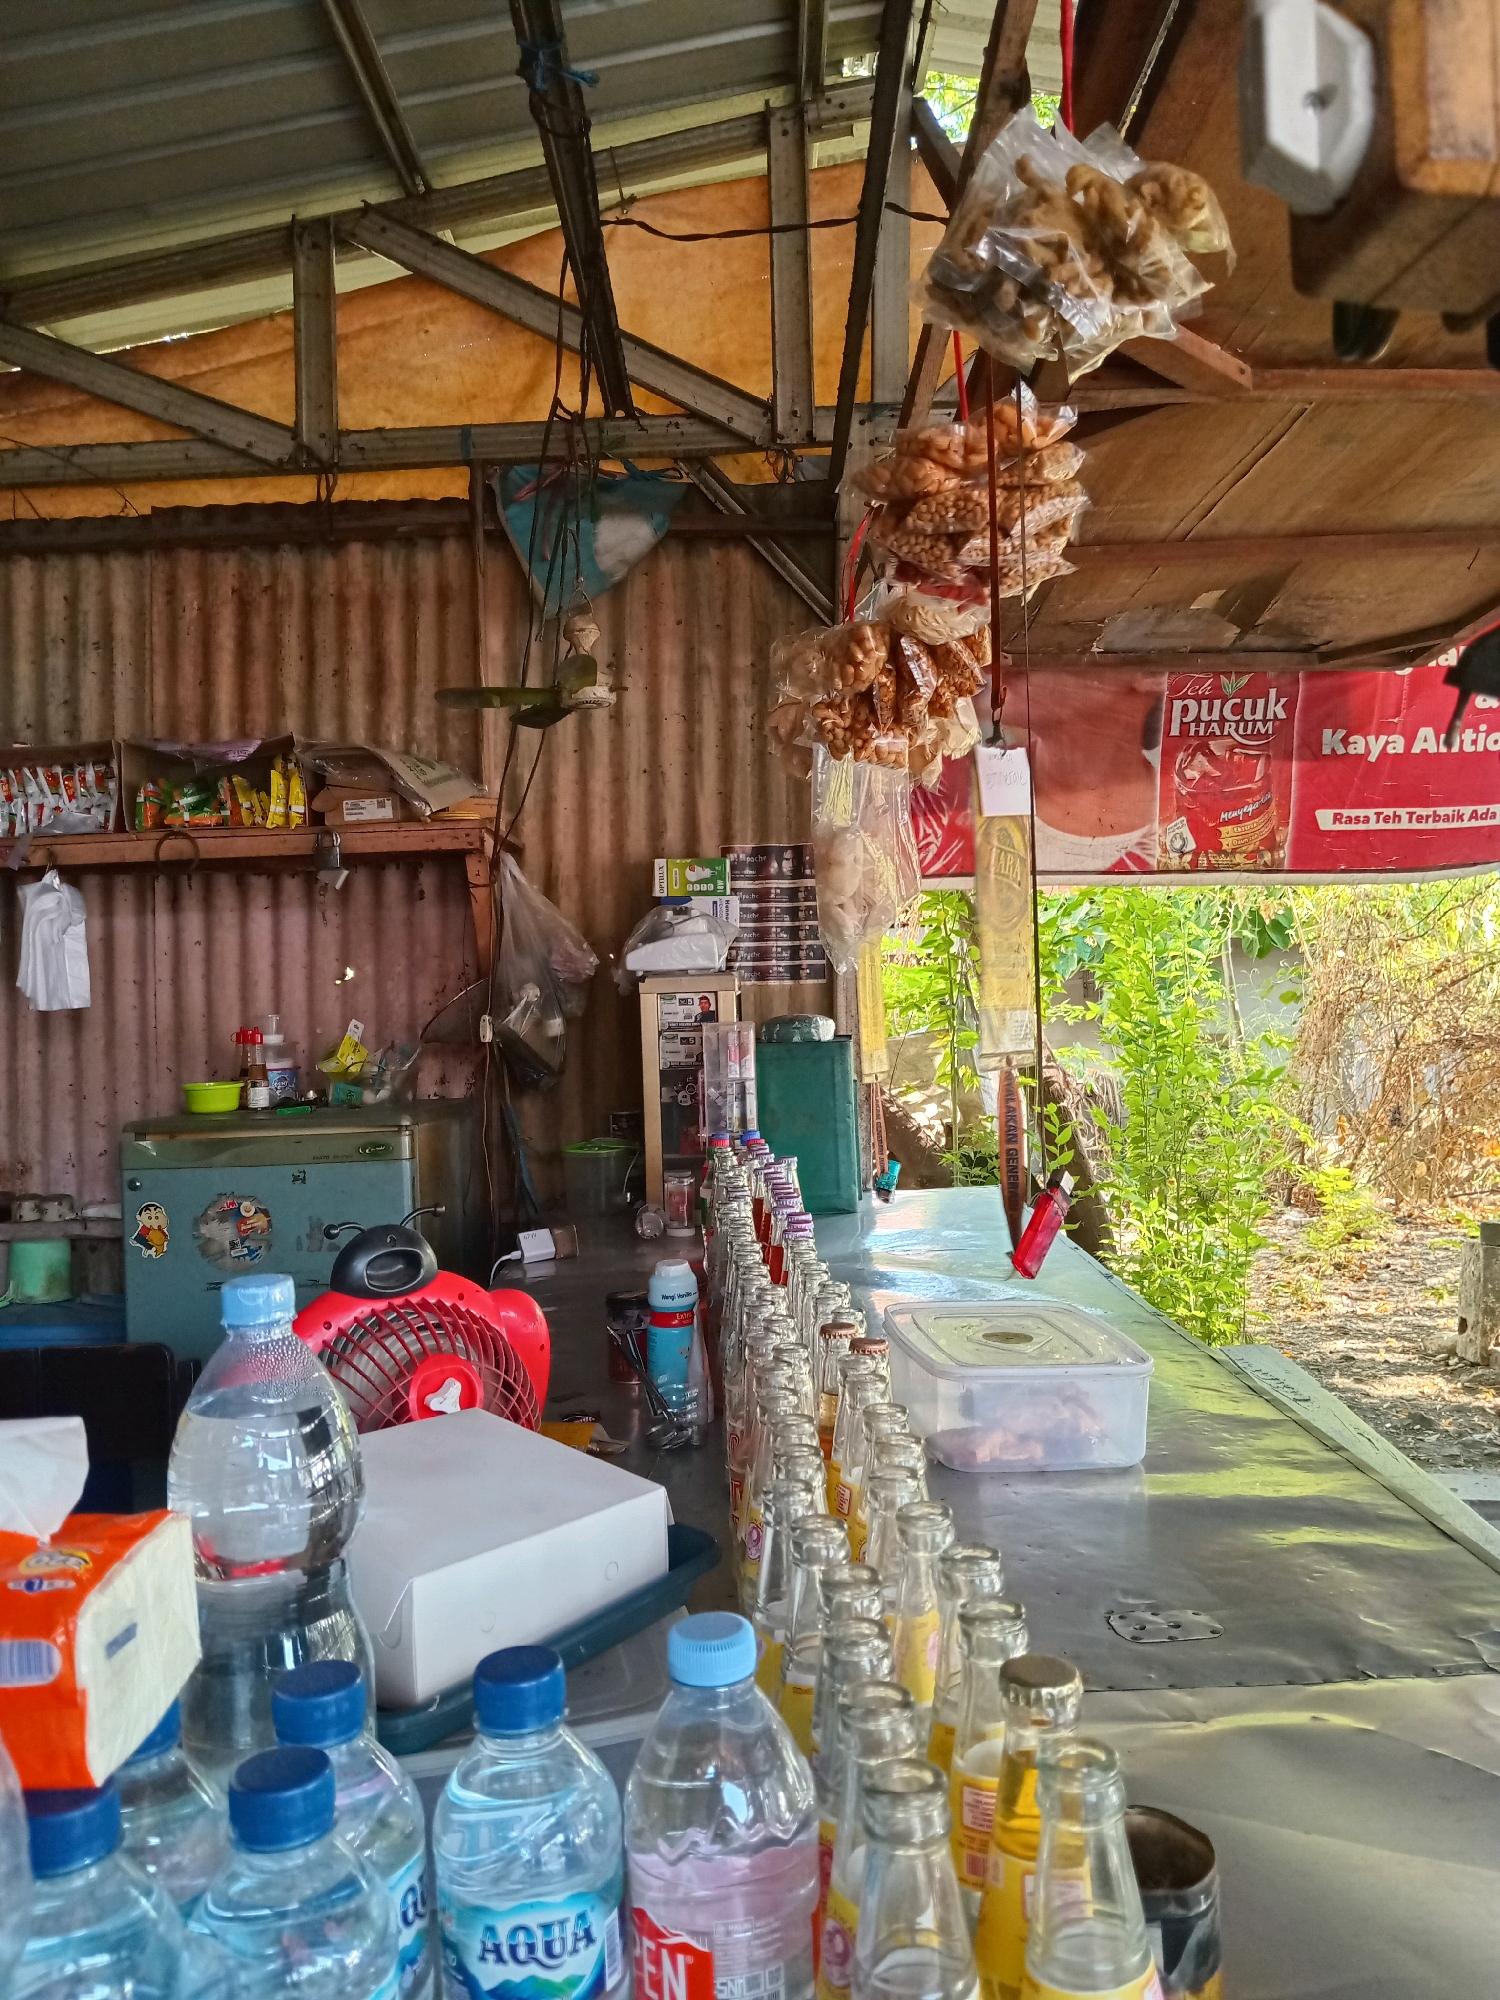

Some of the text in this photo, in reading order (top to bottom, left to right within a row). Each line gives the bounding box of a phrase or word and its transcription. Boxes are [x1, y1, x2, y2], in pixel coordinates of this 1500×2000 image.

[1165, 672, 1213, 698] Teh
[1169, 688, 1289, 736] pucuk
[1189, 721, 1277, 745] HARUM
[1321, 728, 1405, 762] Kaya
[1332, 807, 1497, 826] Rasa Teh Terbaik Ada
[478, 1909, 597, 1971] AQUA
